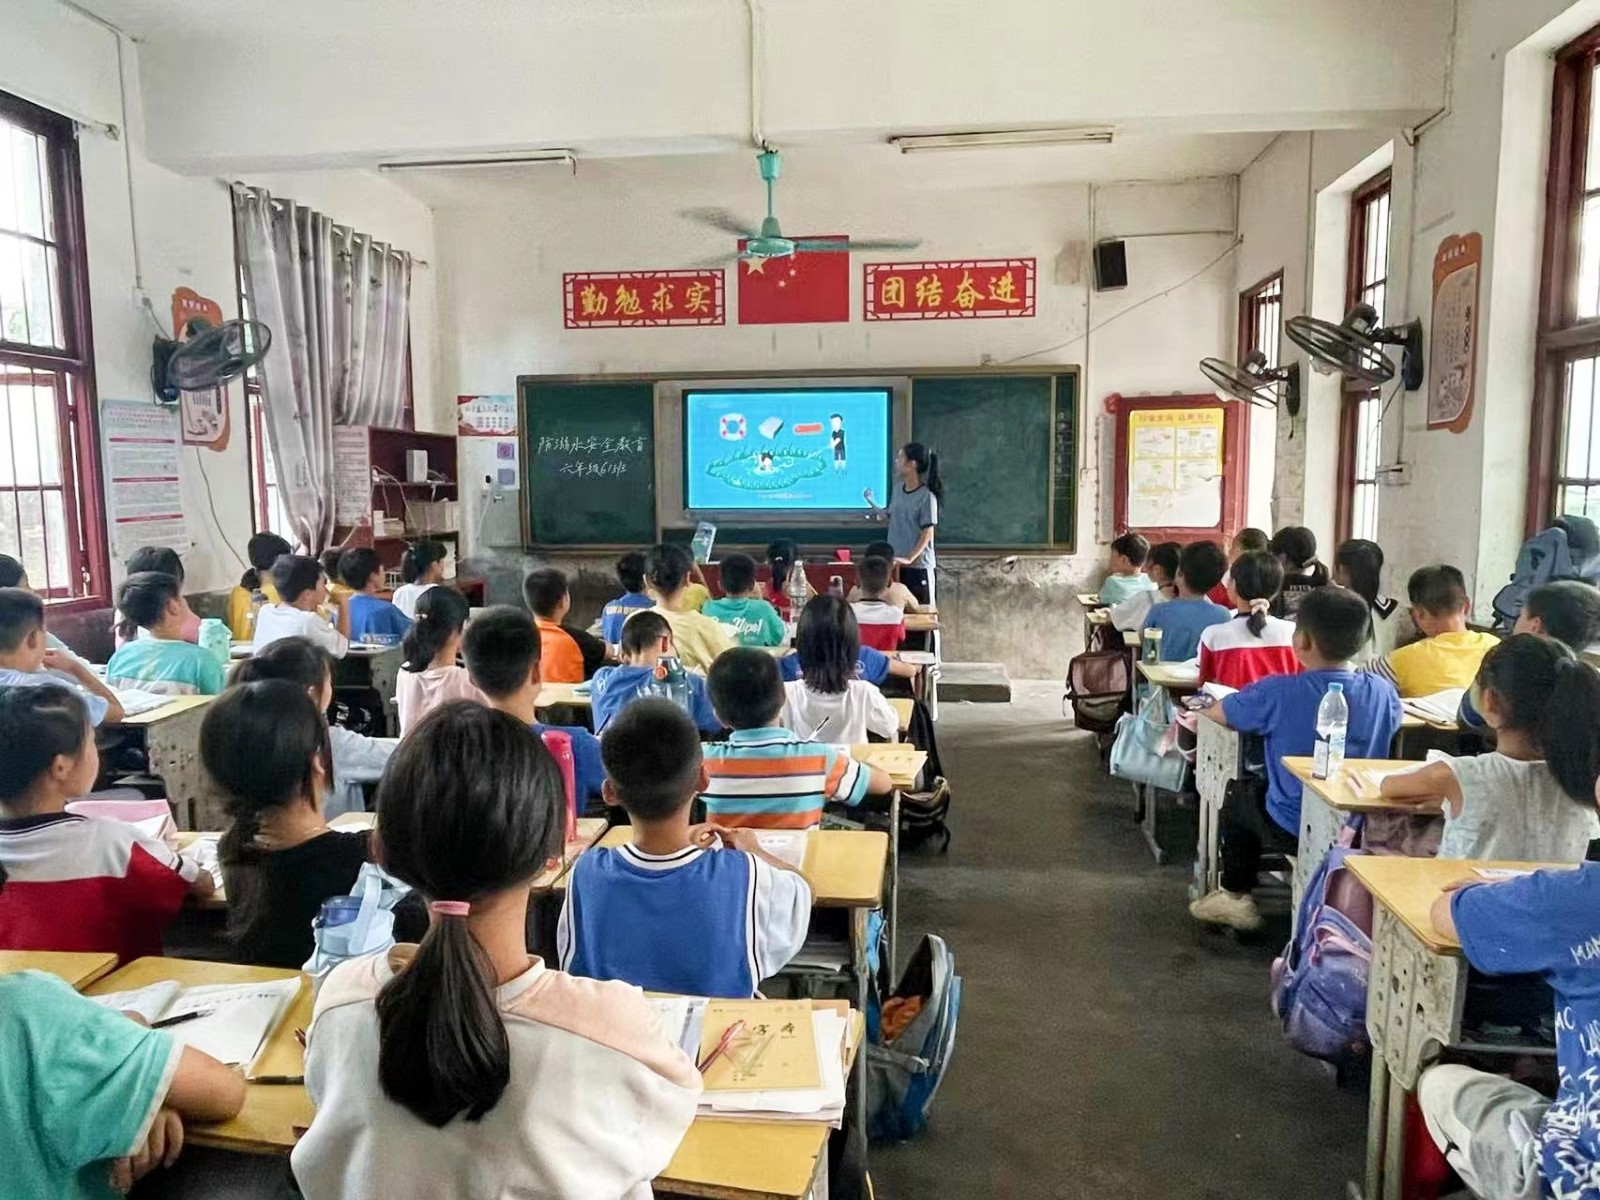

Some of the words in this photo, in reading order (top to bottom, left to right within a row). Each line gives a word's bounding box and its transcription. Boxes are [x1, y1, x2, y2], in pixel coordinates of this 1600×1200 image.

[580, 281, 711, 318] 勤勉求实
[881, 270, 1020, 309] 团结奋进
[537, 435, 648, 455] 防溺水安全教育
